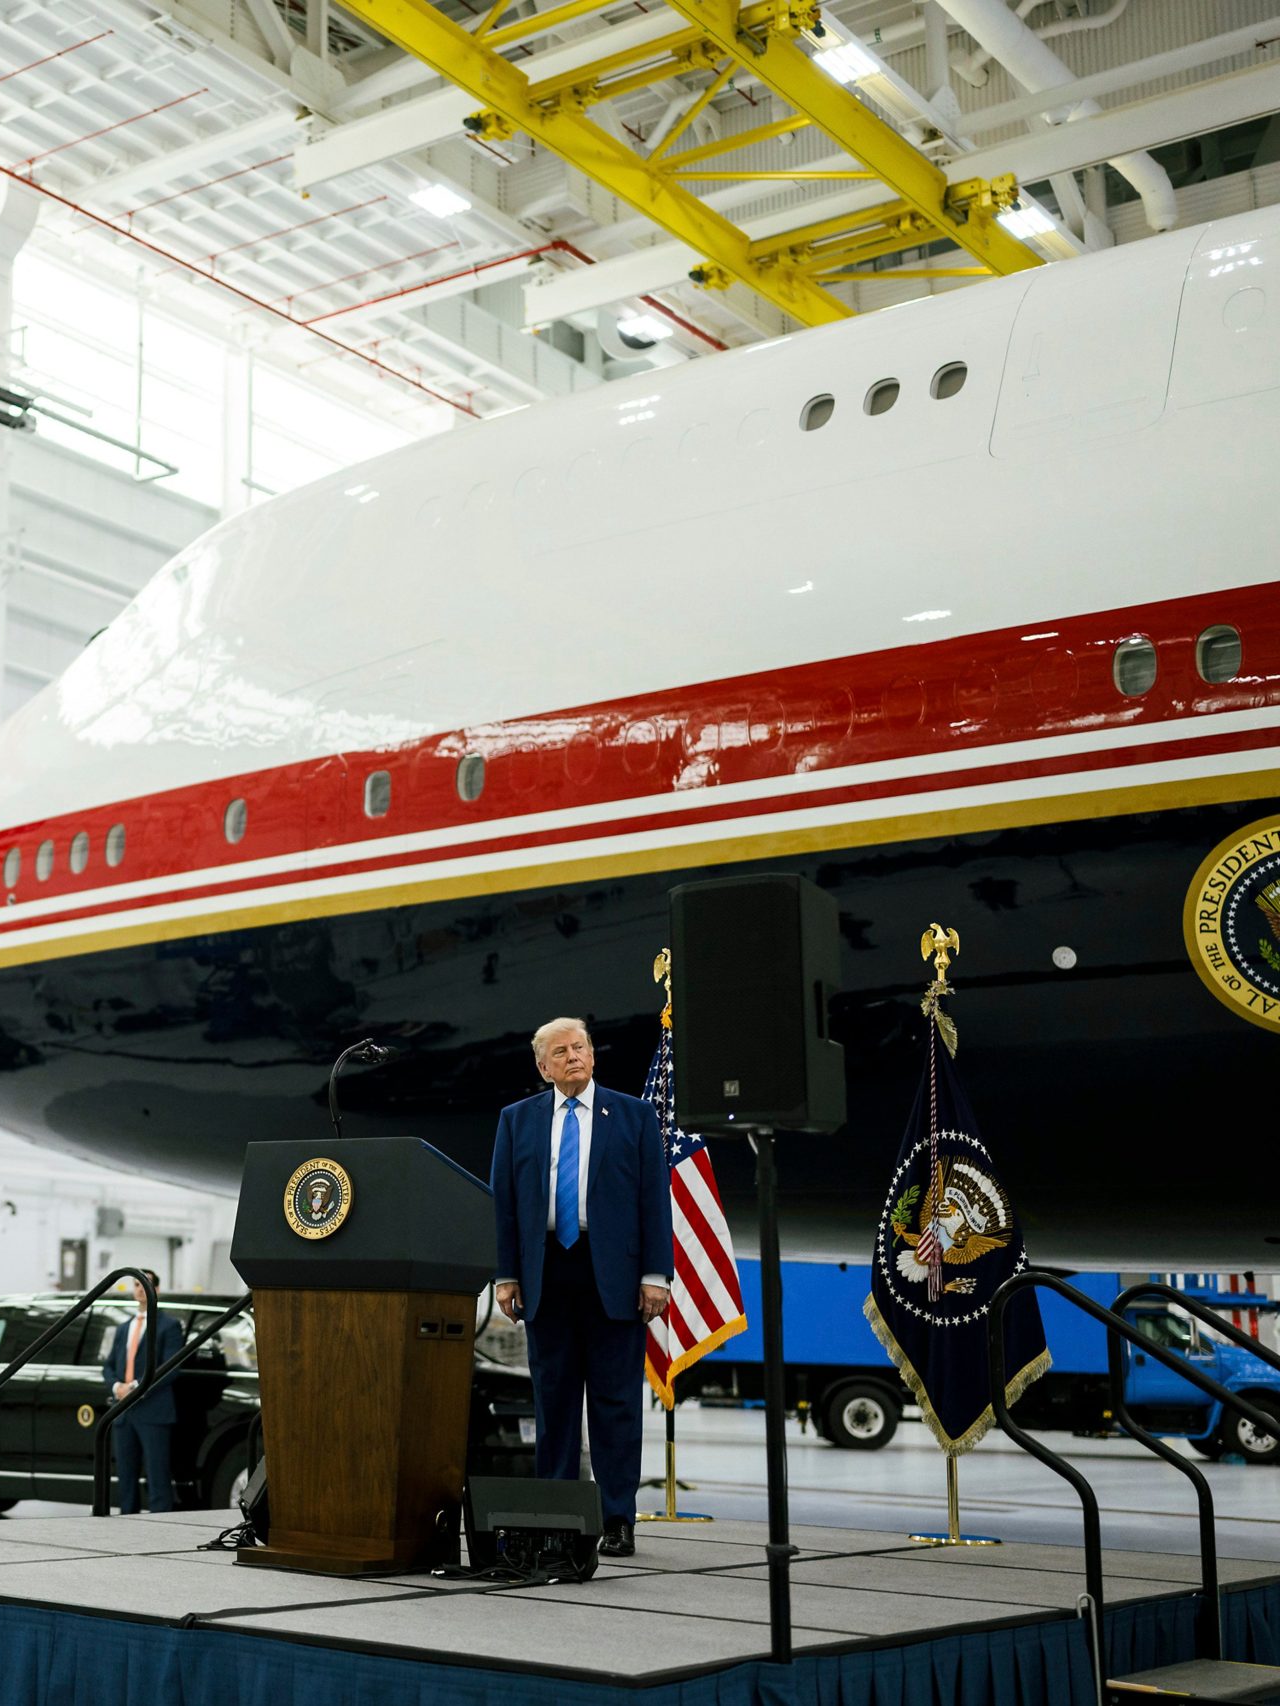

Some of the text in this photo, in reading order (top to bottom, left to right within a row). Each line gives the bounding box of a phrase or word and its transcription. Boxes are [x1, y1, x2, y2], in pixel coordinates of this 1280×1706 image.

[1205, 942, 1226, 971] THE
[1222, 974, 1241, 990] OF
[287, 1161, 320, 1196] PRESIDENT
[337, 1171, 349, 1205] UNITED
[292, 1217, 309, 1235] SEAL
[320, 1211, 345, 1236] STATES
